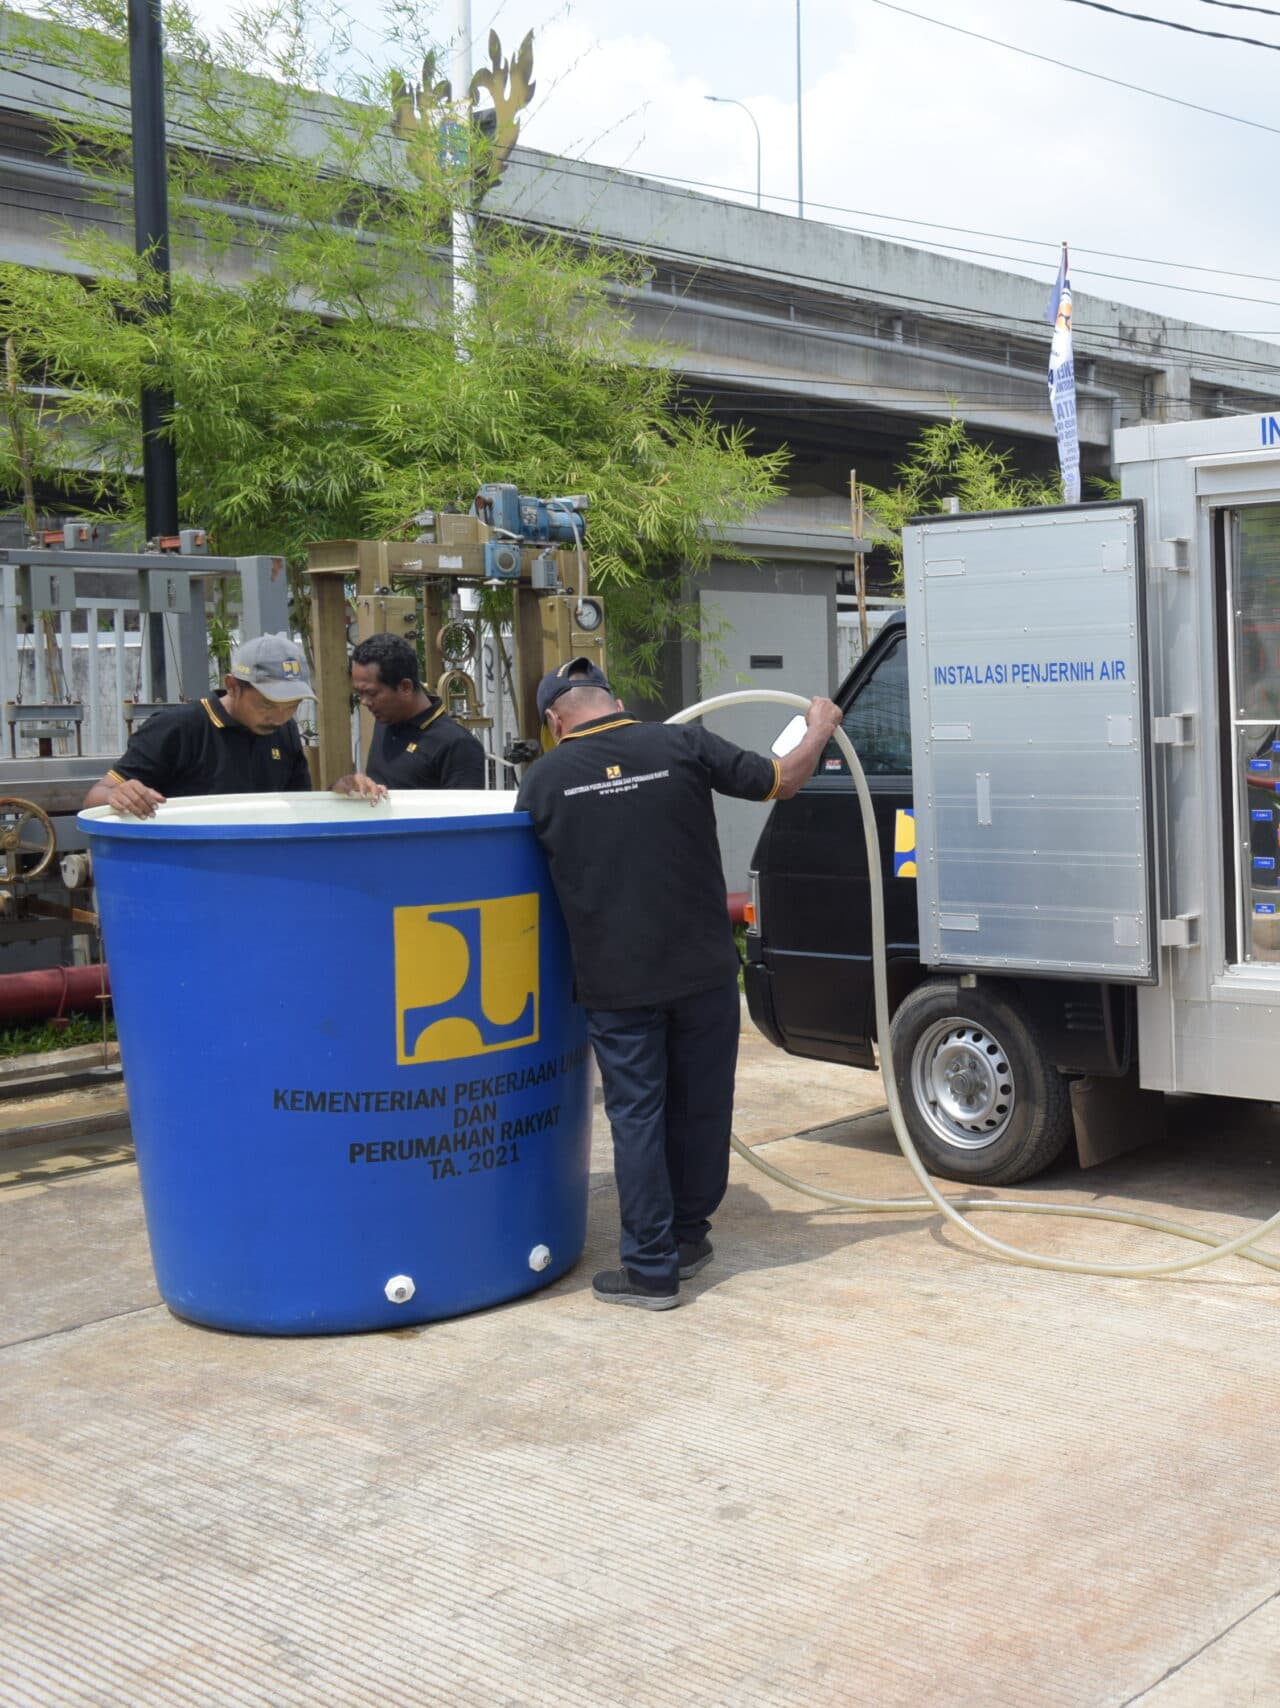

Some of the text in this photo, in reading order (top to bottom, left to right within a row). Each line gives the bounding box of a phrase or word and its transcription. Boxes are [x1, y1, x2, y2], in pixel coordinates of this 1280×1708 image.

[934, 660, 1126, 685] INSTALASI PENJERNIH AIR
[273, 1085, 447, 1113] KEMENTERIAN
[454, 1059, 557, 1105] PEKERJAAN
[349, 1104, 561, 1164] PERUMAHAN RAKYAT
[453, 1101, 497, 1129] DAN
[427, 1142, 520, 1180] TA. 2021
